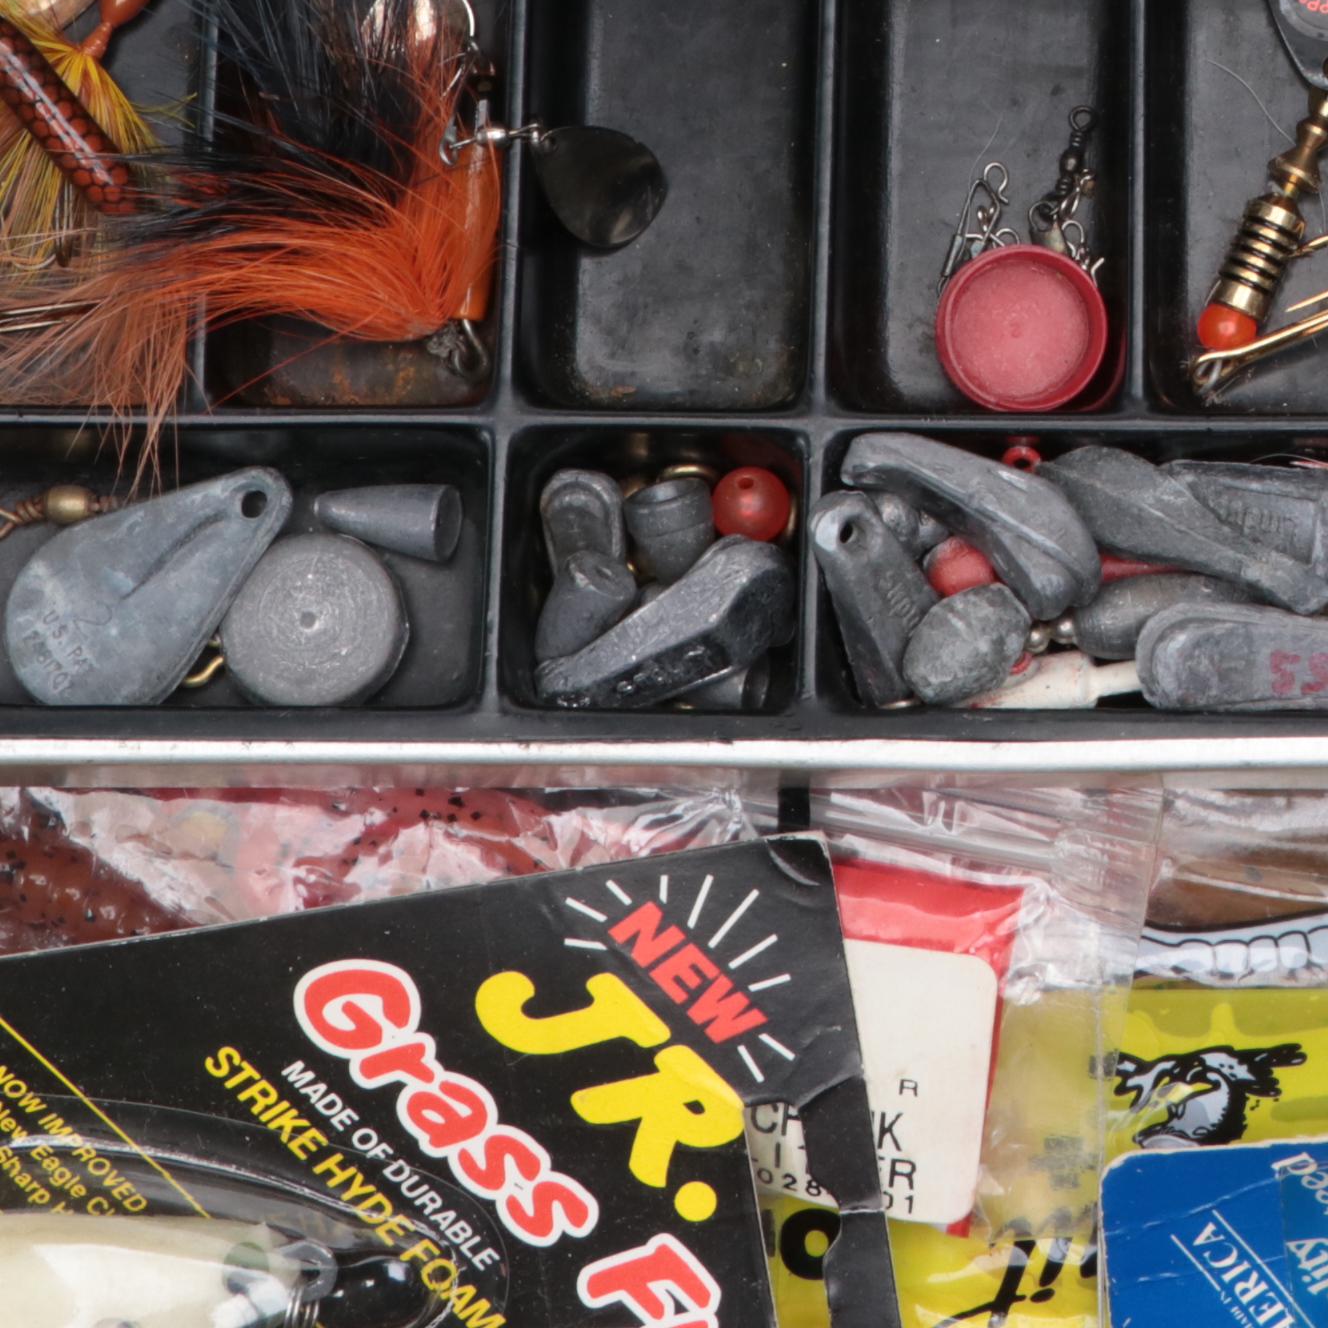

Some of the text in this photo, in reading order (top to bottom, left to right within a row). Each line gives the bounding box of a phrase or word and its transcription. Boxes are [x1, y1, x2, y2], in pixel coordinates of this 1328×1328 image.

[607, 901, 769, 1045] NEW
[0, 1145, 52, 1205] Sharp
[30, 1143, 88, 1199] Eagle
[38, 1112, 148, 1212] IMPROVED
[281, 1059, 500, 1272] MADE OF DURABLE
[293, 958, 599, 1248] Grass
[475, 970, 745, 1222] JR.
[204, 1045, 507, 1328] STRIKE HYDE FOAM
